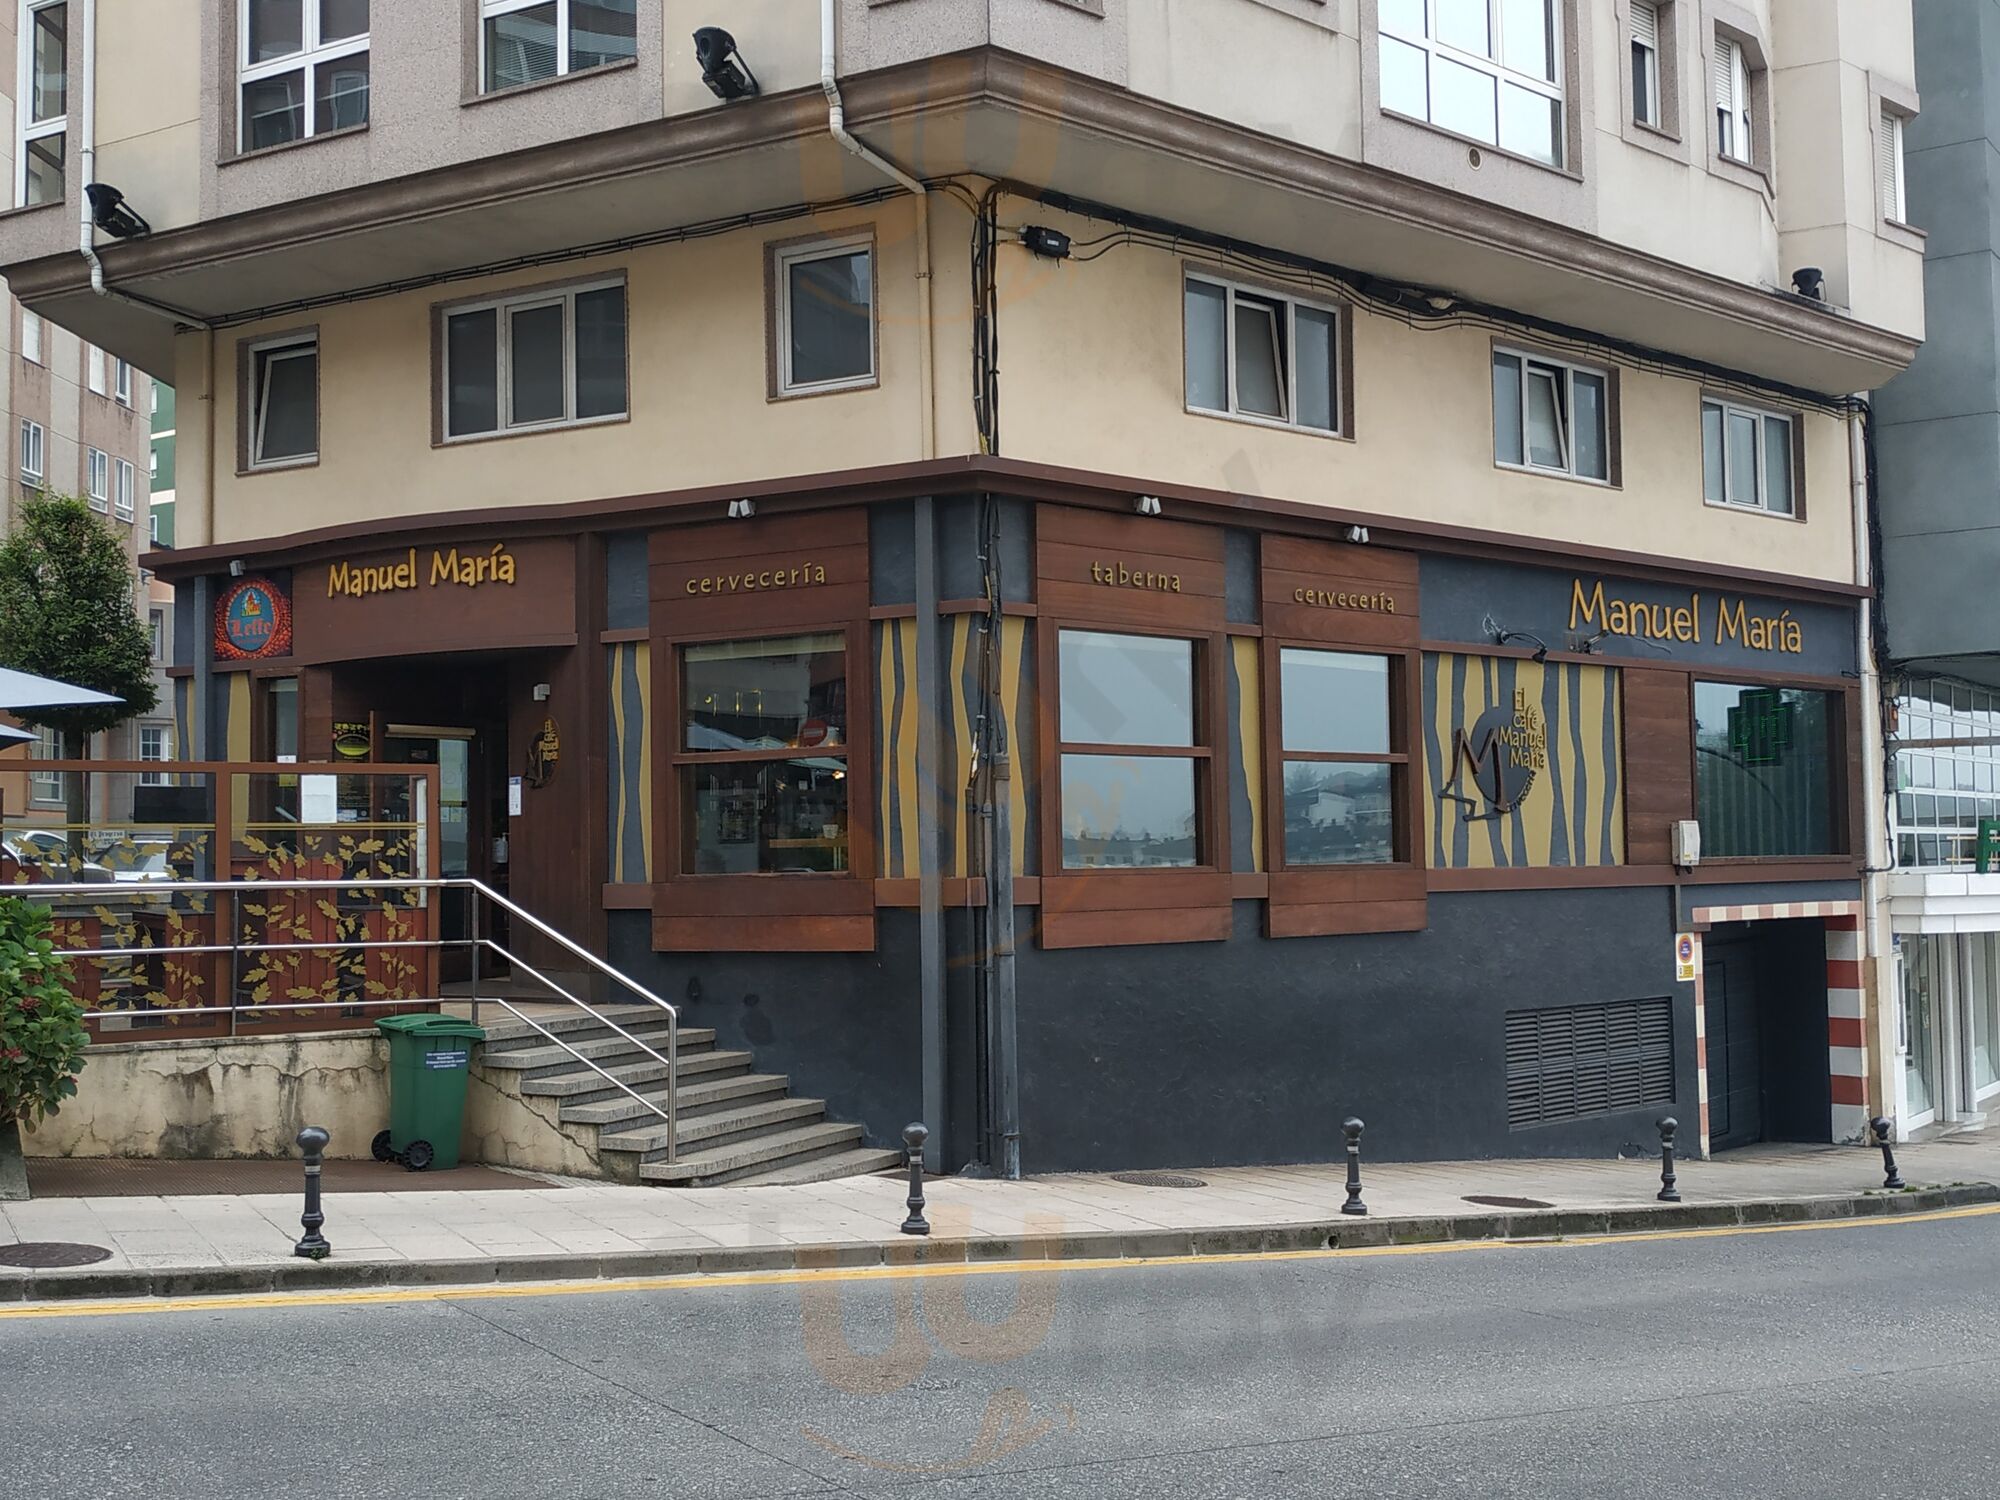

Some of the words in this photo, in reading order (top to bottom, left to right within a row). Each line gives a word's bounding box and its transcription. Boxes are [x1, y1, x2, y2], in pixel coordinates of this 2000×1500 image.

[328, 548, 418, 598] Manuel
[429, 543, 516, 587] María
[686, 562, 827, 595] cervecería
[1091, 561, 1182, 593] taberna
[1294, 586, 1397, 613] cervecería
[1569, 578, 1701, 643] Manuel
[1715, 597, 1802, 653] María
[1499, 722, 1547, 749] Manuel
[1510, 748, 1546, 769] María
